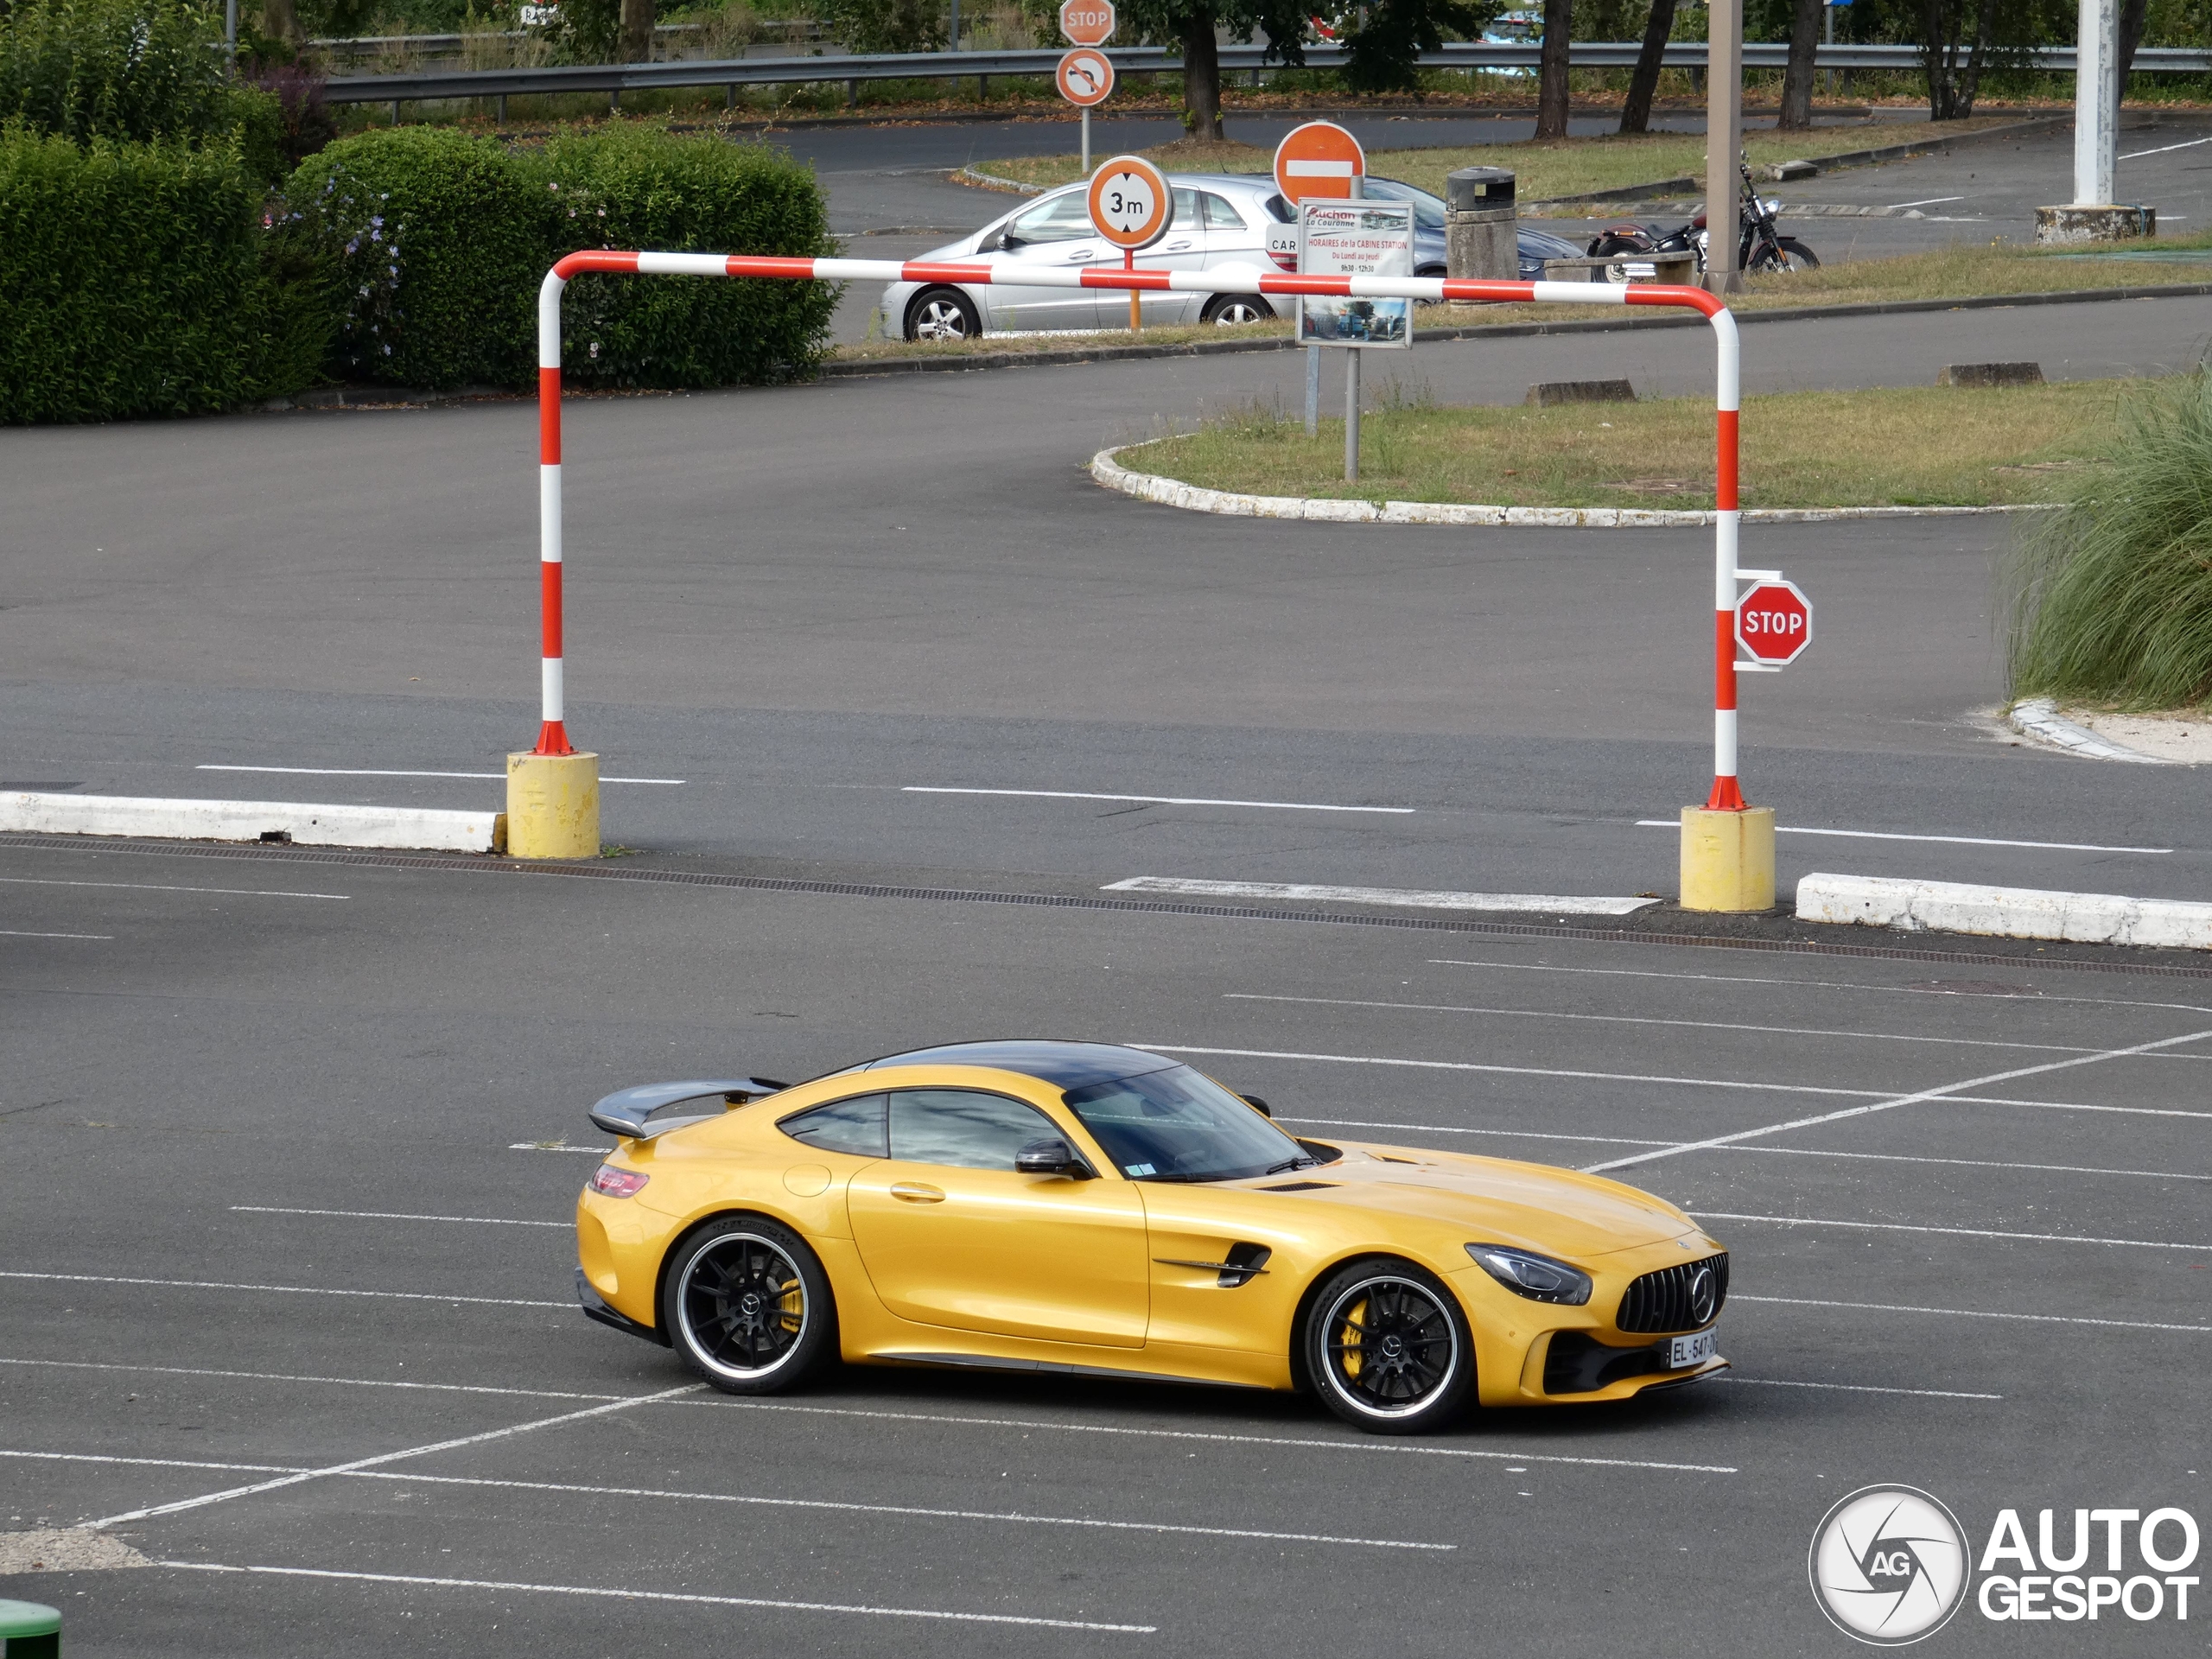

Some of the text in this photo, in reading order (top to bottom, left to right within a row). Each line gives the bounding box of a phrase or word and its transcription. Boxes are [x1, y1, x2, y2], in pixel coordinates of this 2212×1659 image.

[1068, 11, 1108, 27] STOP
[1306, 207, 1355, 219] Auchan
[1318, 219, 1356, 227] Couronne
[1308, 238, 1339, 247] HORAIRES
[1350, 239, 1356, 248] la
[1357, 239, 1380, 249] CABINE
[1381, 240, 1408, 250] STATION
[1341, 251, 1357, 260] Lundi
[1365, 252, 1380, 262] Jeudi
[1745, 611, 1802, 634] STOP
